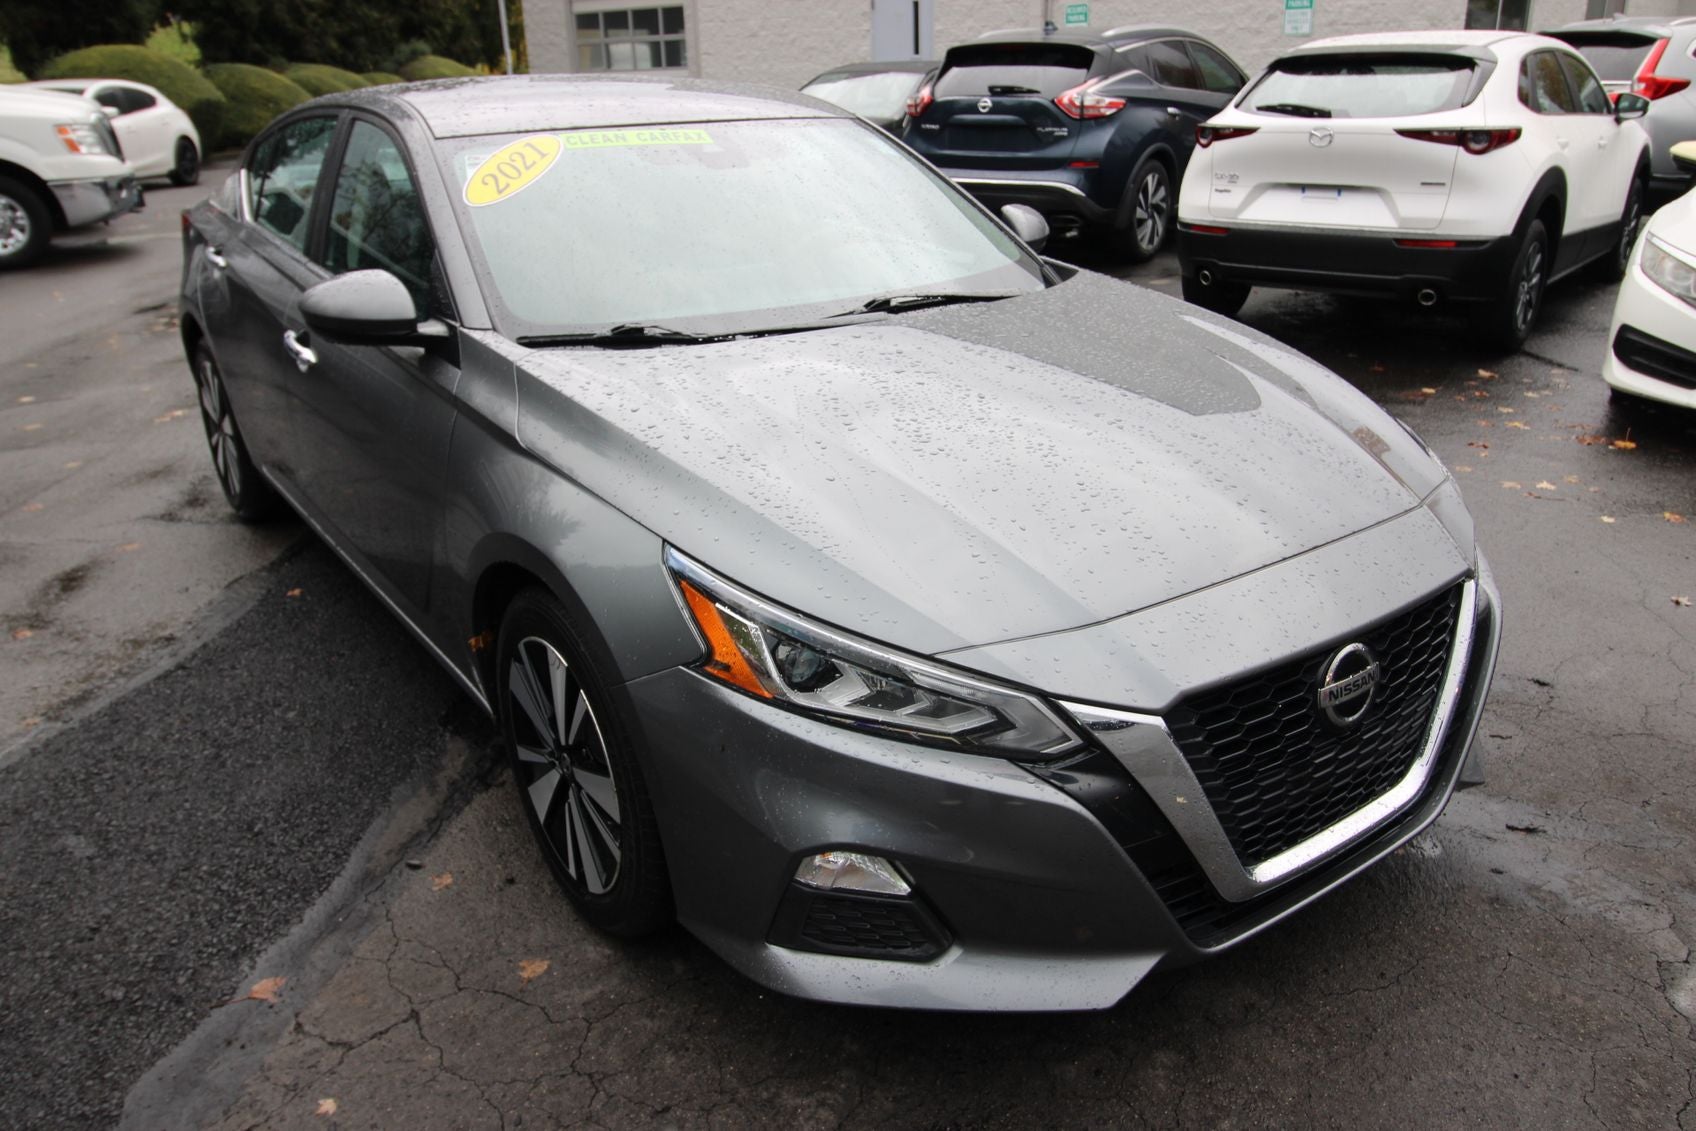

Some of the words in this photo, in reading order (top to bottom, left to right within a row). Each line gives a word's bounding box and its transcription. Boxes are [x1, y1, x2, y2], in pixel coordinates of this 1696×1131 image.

[565, 133, 627, 146] CLEAN
[635, 131, 706, 143] CARFAX
[481, 141, 549, 195] 2021
[1328, 670, 1375, 701] NISSAN
